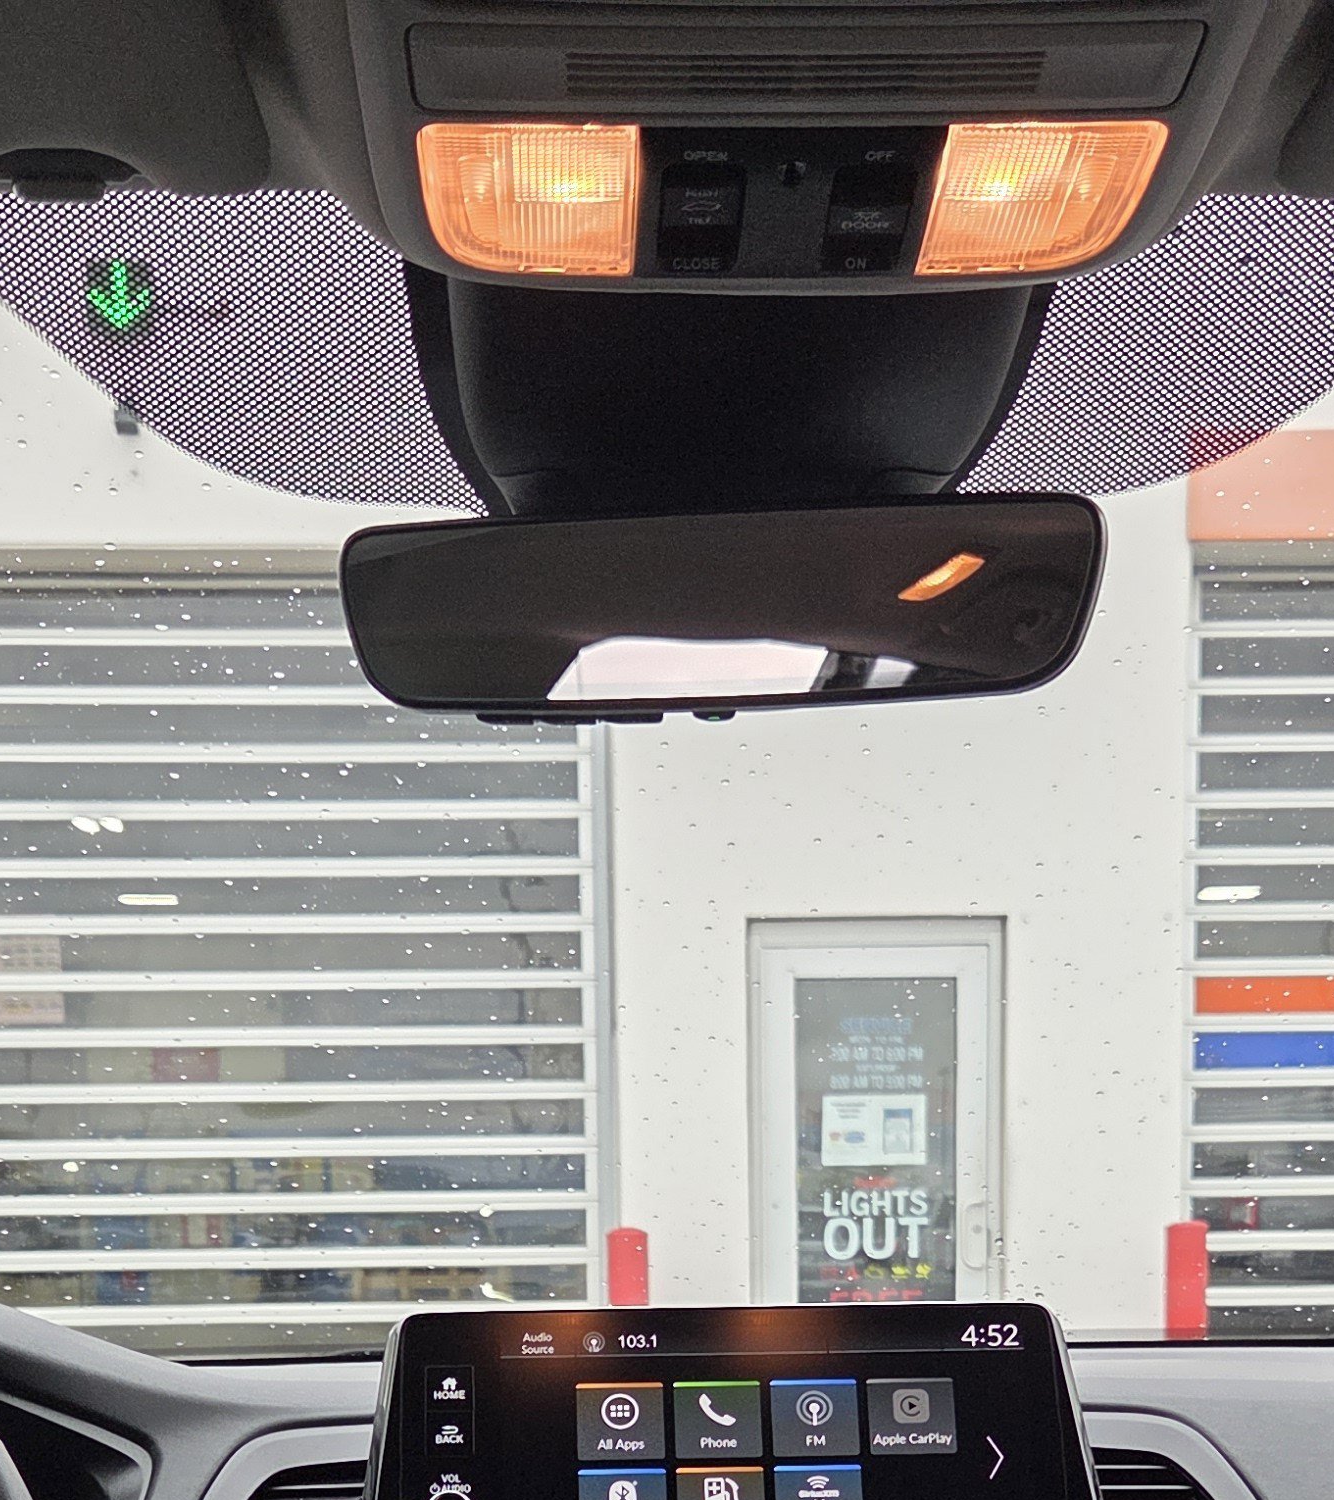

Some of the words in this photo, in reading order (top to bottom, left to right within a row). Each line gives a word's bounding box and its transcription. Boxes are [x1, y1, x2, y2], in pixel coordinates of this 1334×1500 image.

[672, 258, 721, 270] CLOSE
[845, 258, 867, 270] ON
[823, 1189, 929, 1217] LIGHTS
[823, 1216, 930, 1261] OUT
[522, 1332, 553, 1343] Audio
[617, 1334, 658, 1349] 103.1
[960, 1323, 1020, 1348] 4:52
[521, 1344, 555, 1355] Source
[433, 1389, 466, 1401] HOME
[435, 1433, 464, 1444] BACK
[700, 1436, 738, 1448] Phone
[805, 1434, 827, 1447] FM
[872, 1432, 907, 1446] Apple
[908, 1432, 953, 1446] CarPlay
[597, 1438, 613, 1450] All
[615, 1439, 645, 1452] Apps
[441, 1473, 461, 1483] VOL
[441, 1483, 472, 1494] AUDIO
